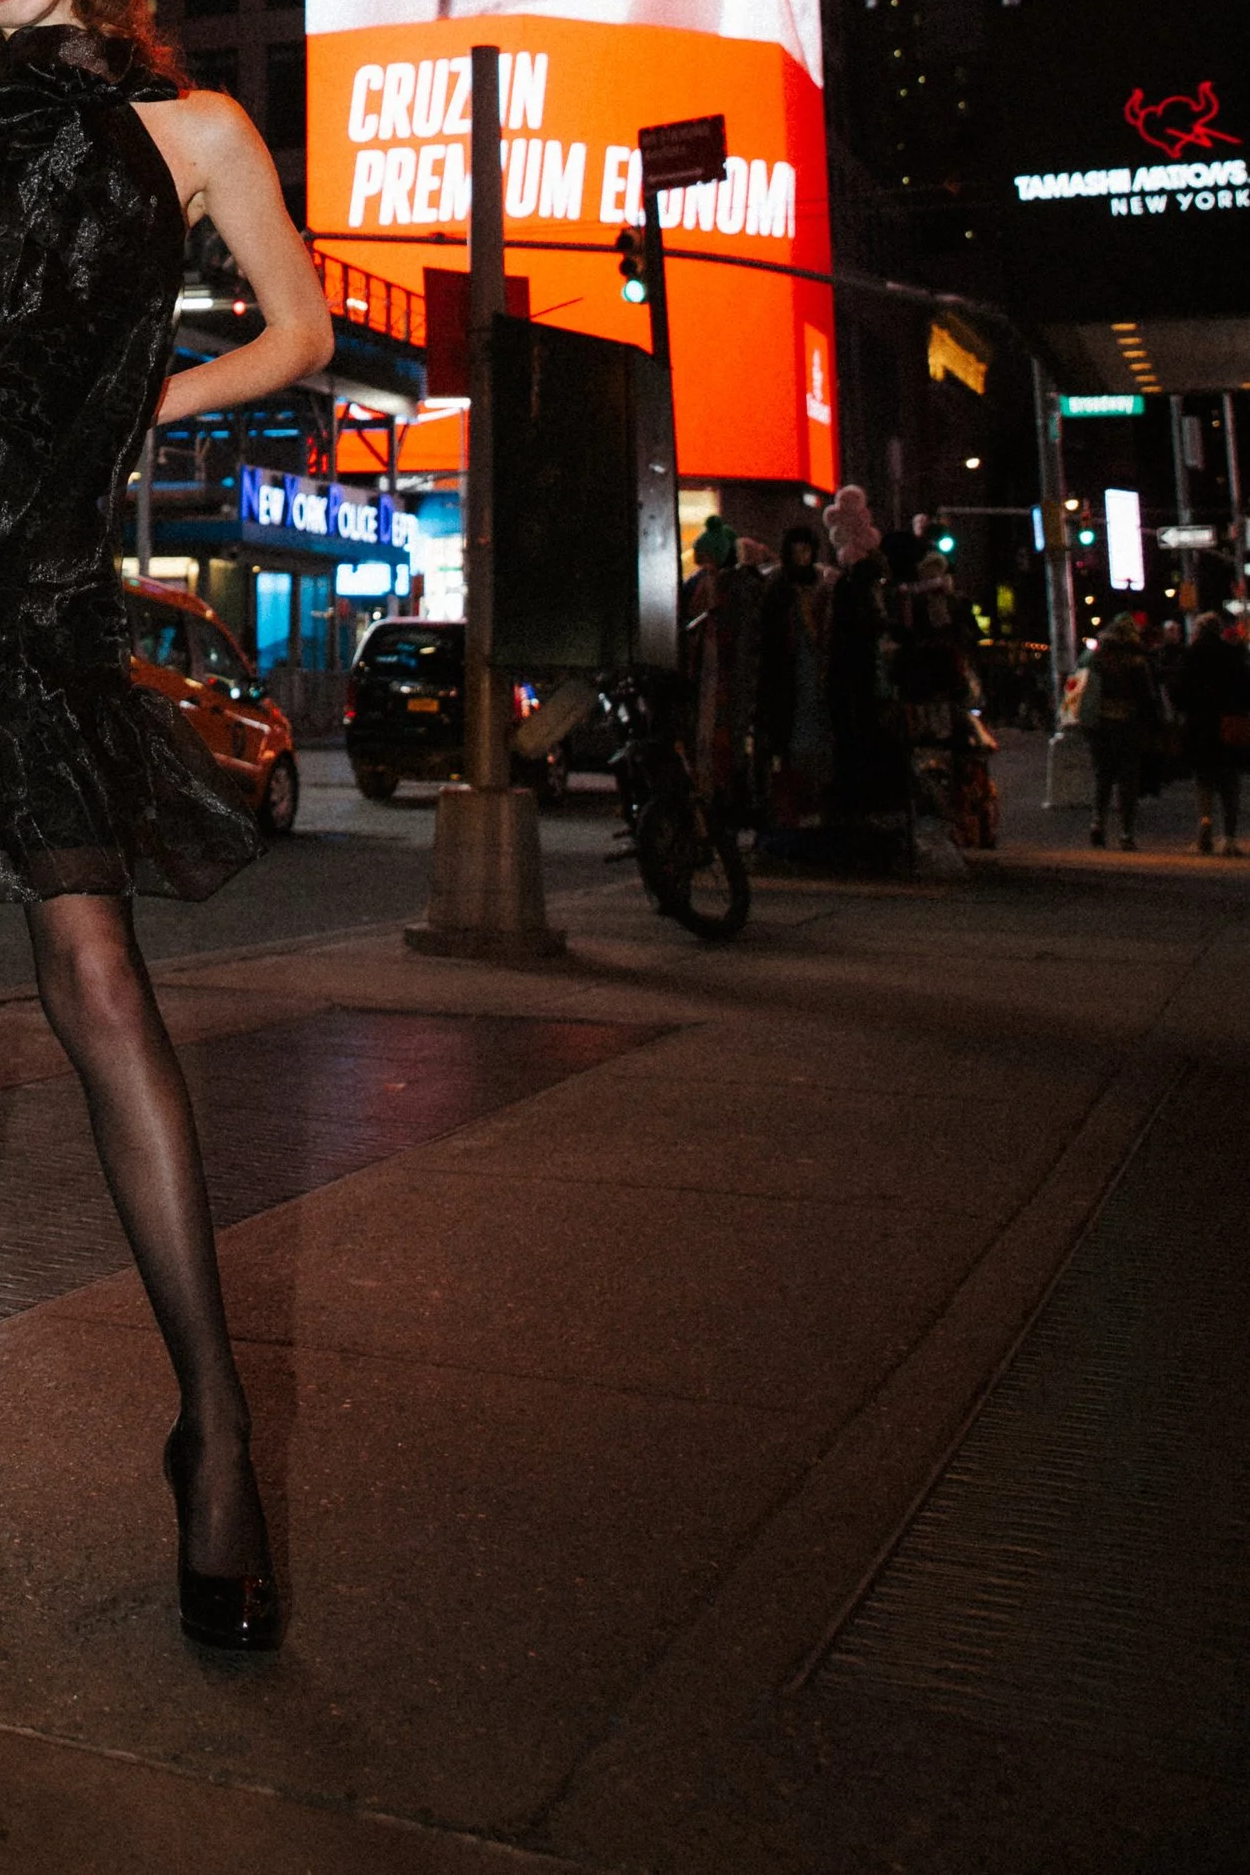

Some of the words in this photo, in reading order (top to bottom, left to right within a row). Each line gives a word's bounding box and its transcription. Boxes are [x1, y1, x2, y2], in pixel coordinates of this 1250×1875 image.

[348, 137, 588, 228] PREMUM
[599, 144, 797, 240] ECONOM
[1110, 194, 1168, 217] NEW
[1176, 188, 1250, 212] YORK
[283, 473, 329, 536] YORK
[328, 482, 379, 544] POLICE
